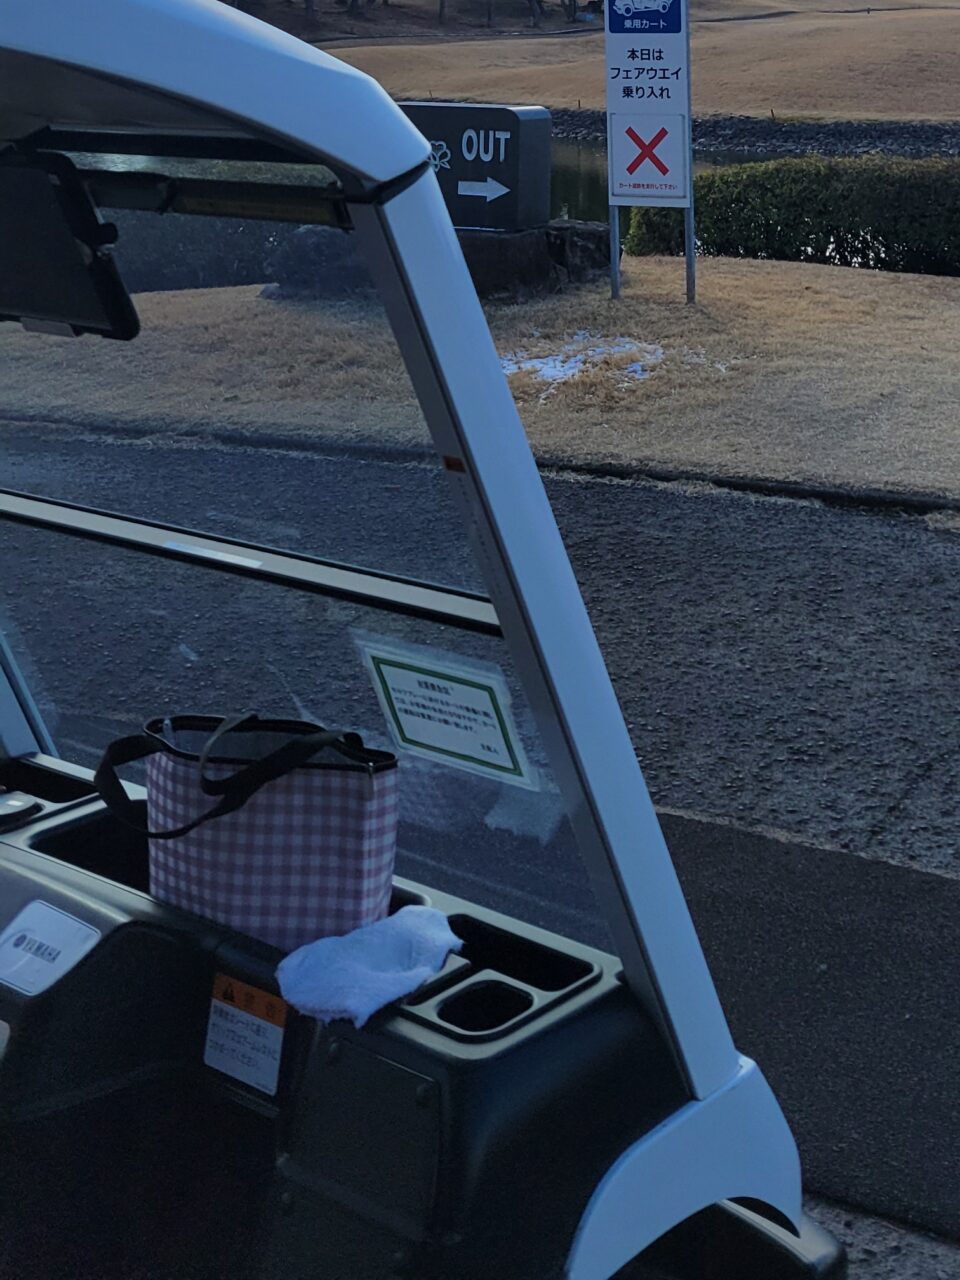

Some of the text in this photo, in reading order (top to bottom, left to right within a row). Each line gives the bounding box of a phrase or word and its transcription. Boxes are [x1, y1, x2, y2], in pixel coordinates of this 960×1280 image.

[623, 19, 668, 29] 乗用カート
[627, 47, 665, 61] 本日は
[610, 67, 682, 80] フェアウエイ
[622, 86, 672, 99] 乗り入れ
[461, 128, 511, 163] OUT
